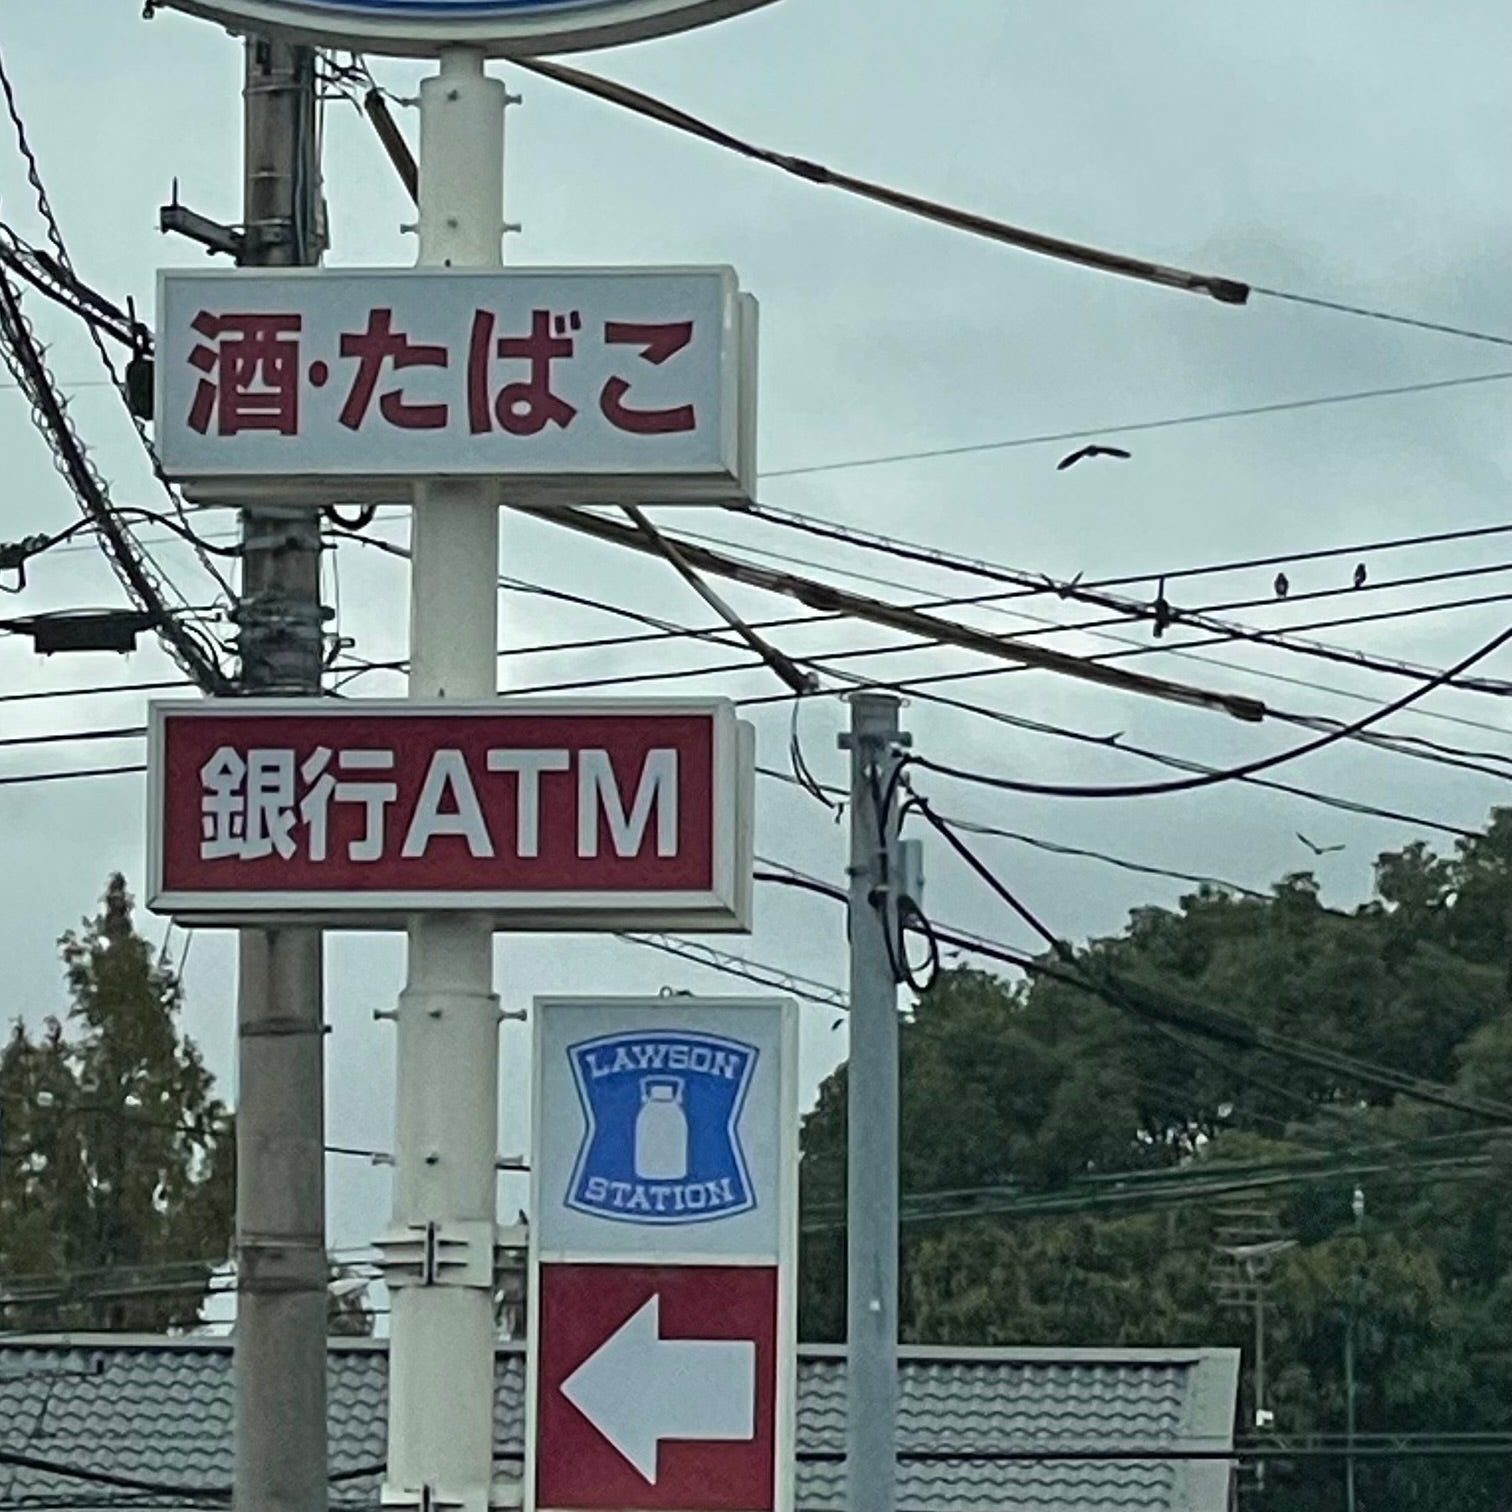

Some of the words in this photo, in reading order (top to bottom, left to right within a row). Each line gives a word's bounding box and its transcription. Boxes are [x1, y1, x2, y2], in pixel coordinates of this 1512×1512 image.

[187, 308, 697, 436] 酒・たばこ
[199, 745, 679, 861] 銀行ATM
[585, 1044, 739, 1080] LAWSON
[584, 1177, 734, 1211] STATION
